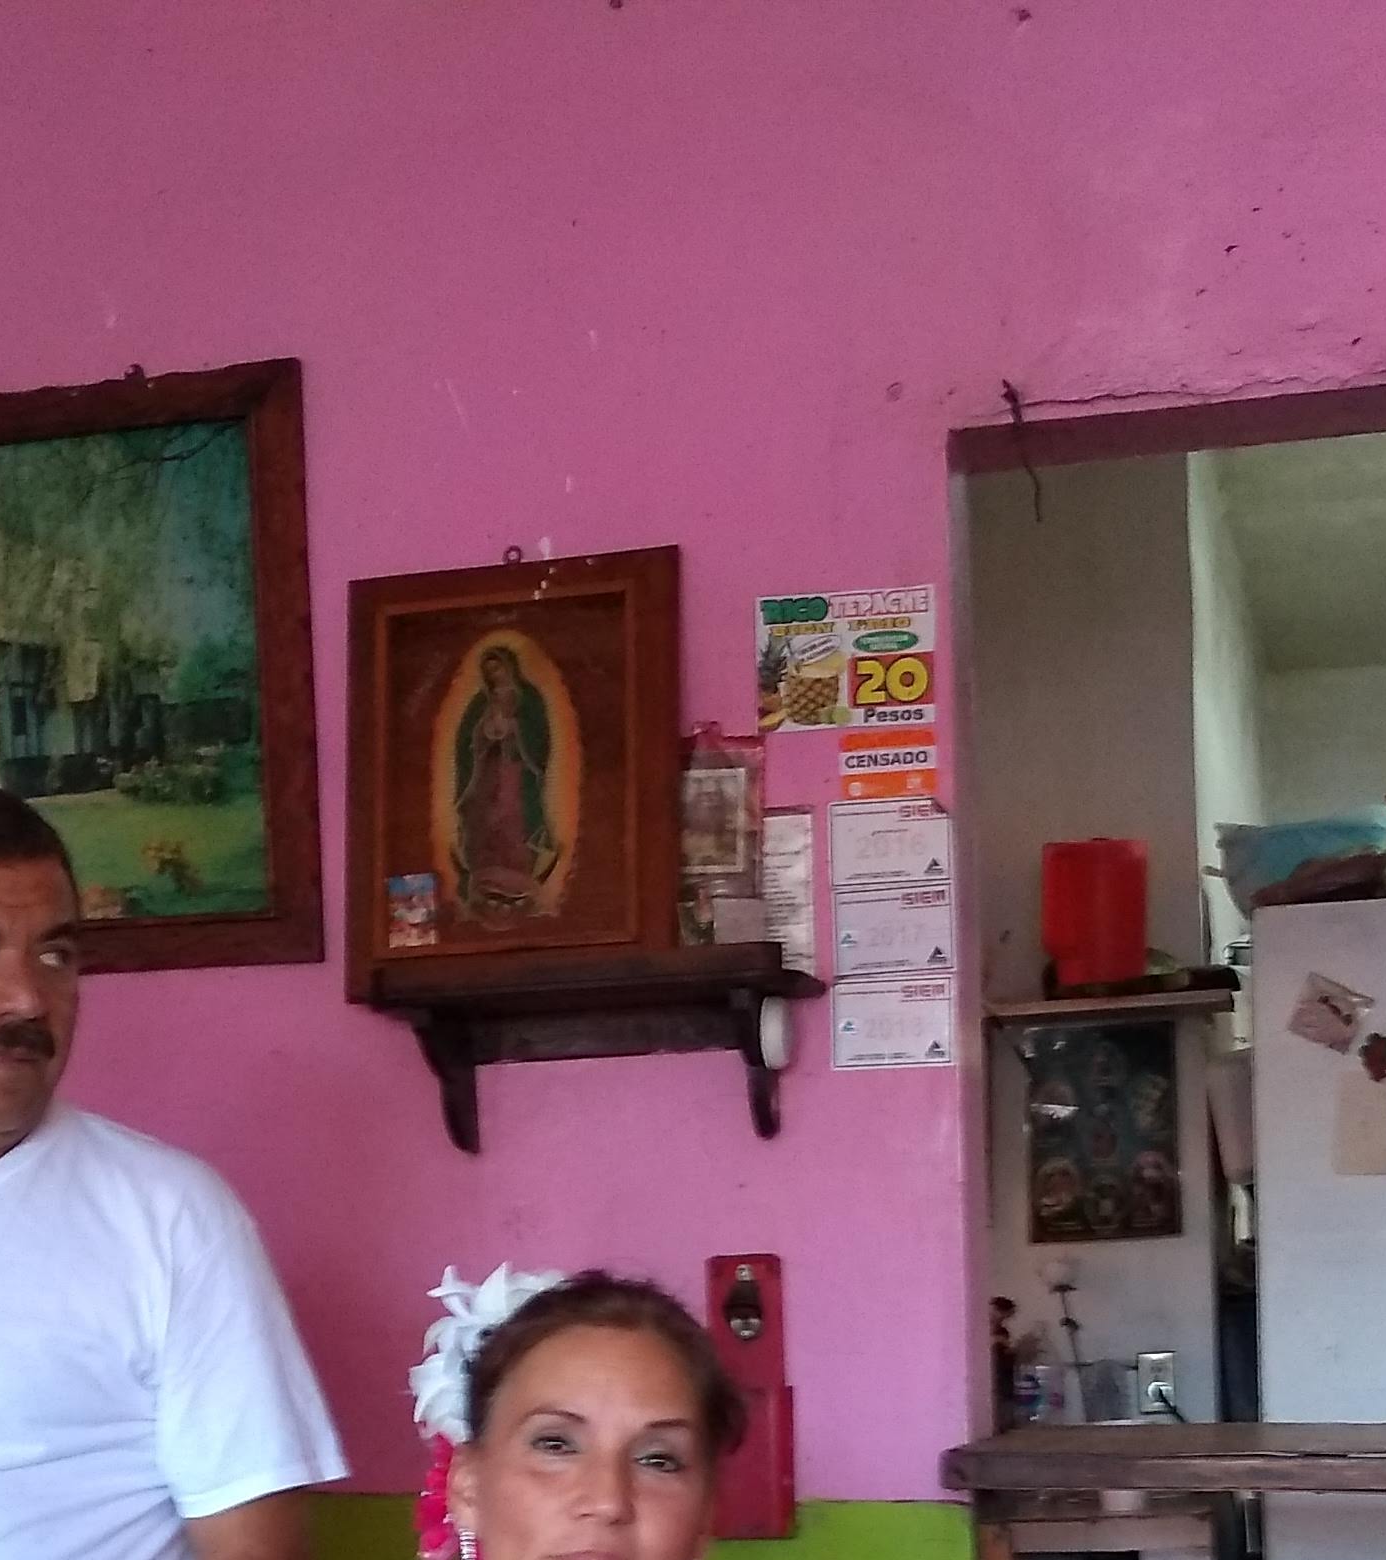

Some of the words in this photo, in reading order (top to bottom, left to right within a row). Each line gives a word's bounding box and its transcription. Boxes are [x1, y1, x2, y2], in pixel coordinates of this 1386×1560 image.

[828, 588, 928, 619] TEPACHE
[856, 656, 929, 705] 20
[863, 708, 924, 723] Pesos
[844, 750, 928, 769] CENSADO
[901, 889, 945, 905] SIEM
[901, 984, 945, 998] SIEM
